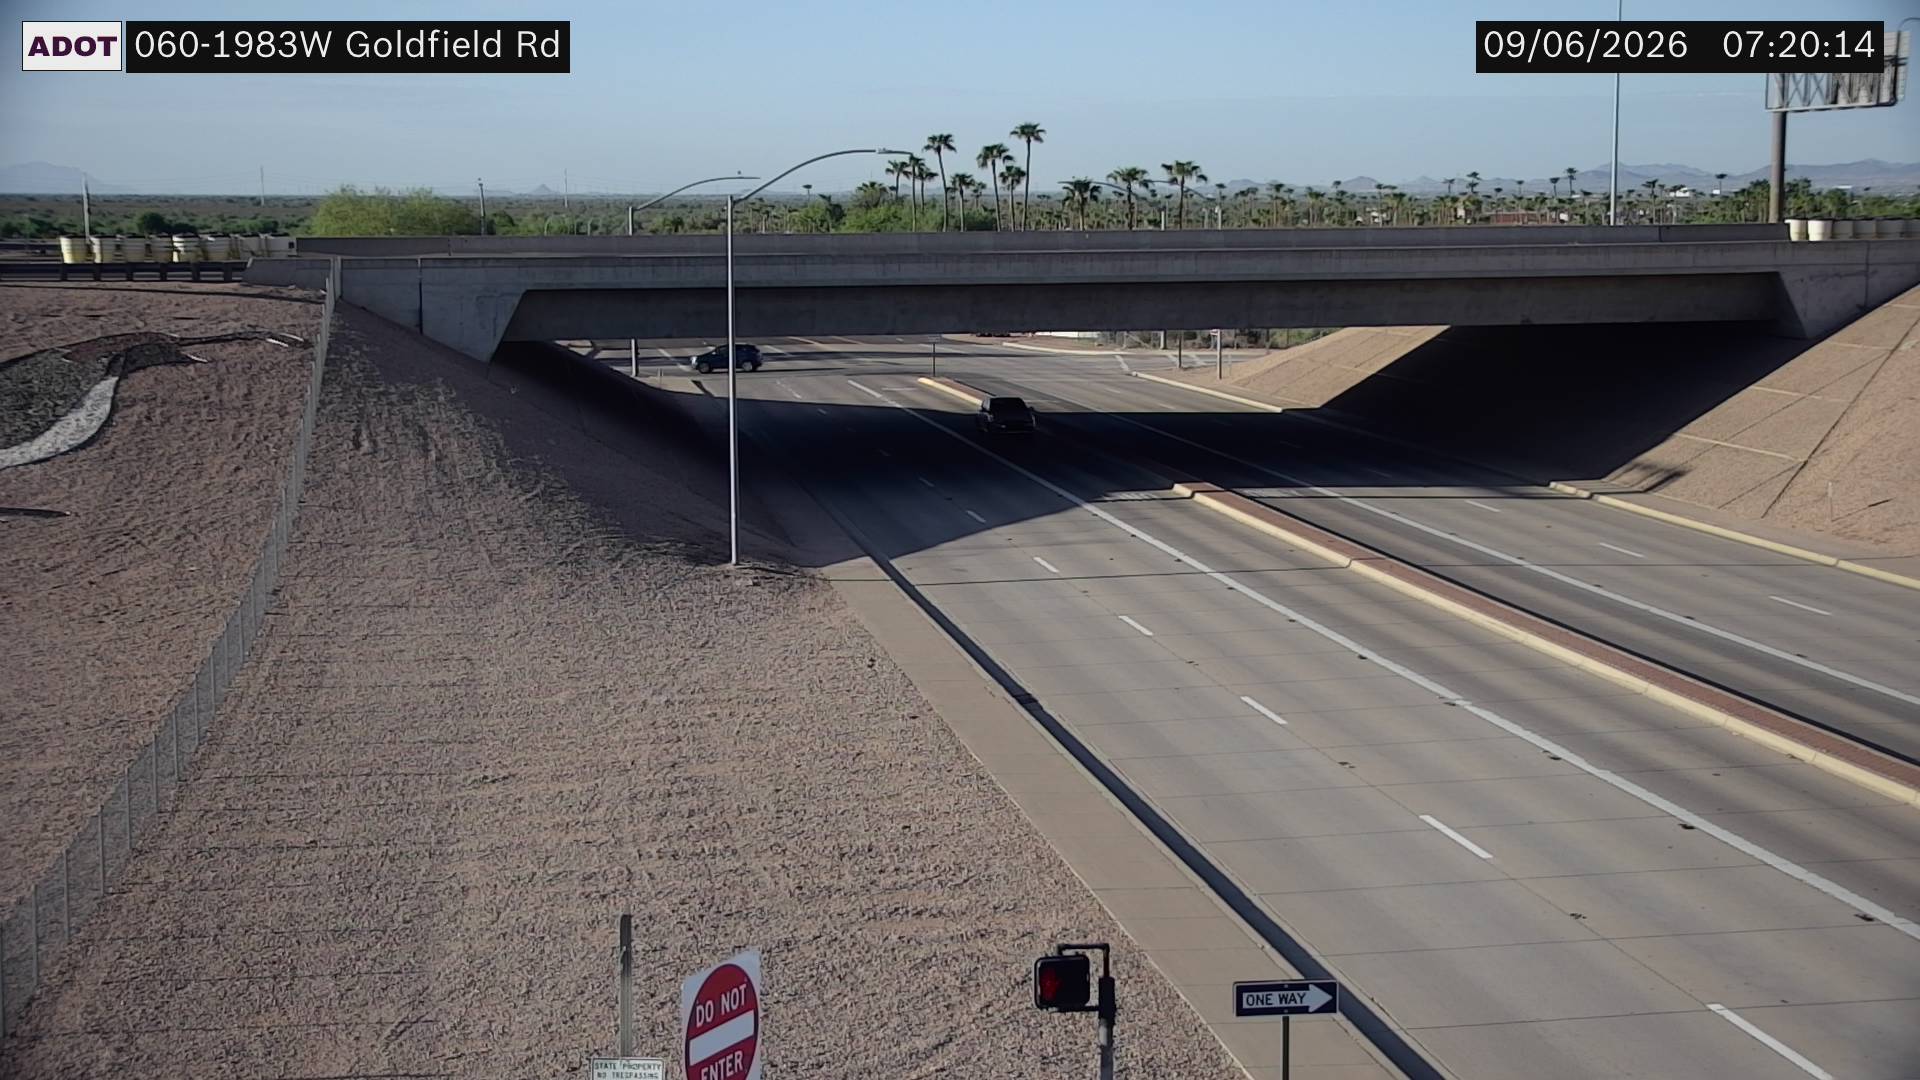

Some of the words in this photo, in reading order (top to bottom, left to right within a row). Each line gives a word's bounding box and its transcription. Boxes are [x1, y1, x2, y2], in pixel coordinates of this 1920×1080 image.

[696, 1000, 714, 1028] DO
[721, 983, 747, 1015] NOT
[1246, 994, 1273, 1007] ONE
[1278, 993, 1306, 1005] WAY
[594, 1062, 617, 1070] STATE
[622, 1062, 661, 1070] PROPERTY
[701, 1050, 743, 1080] ENTER
[597, 1071, 607, 1079] NO
[612, 1071, 659, 1079] TRESPASSING
